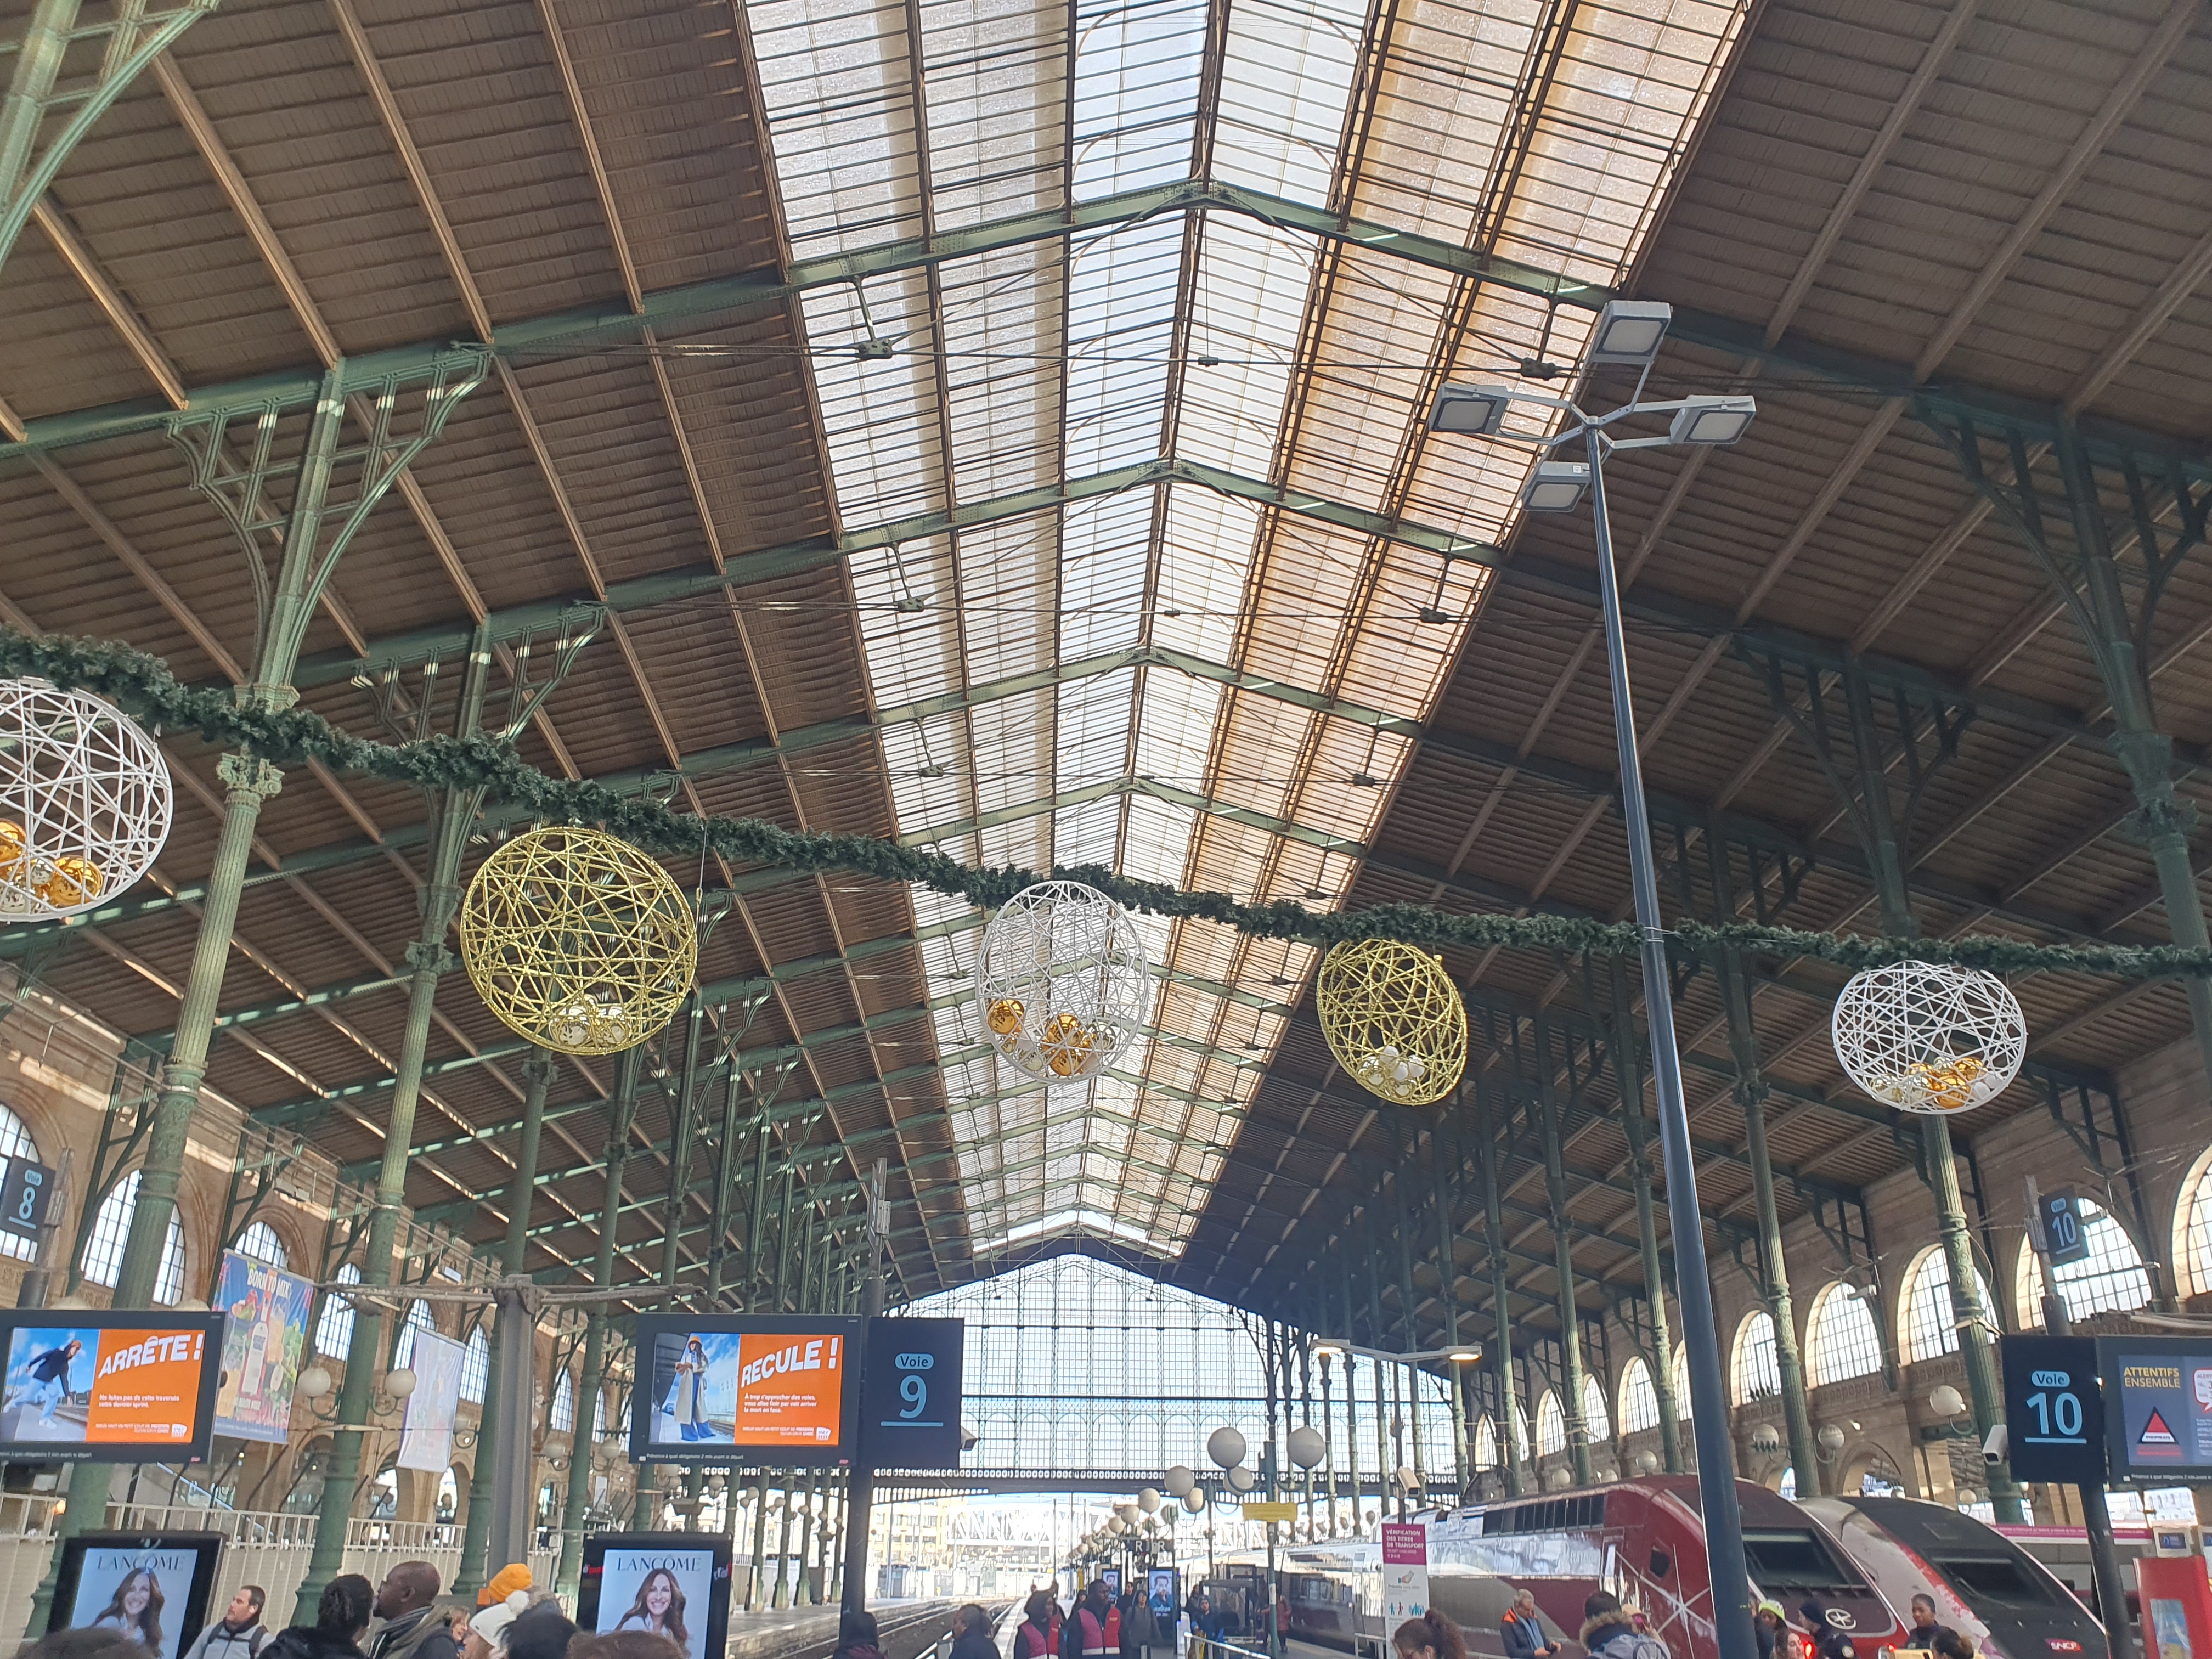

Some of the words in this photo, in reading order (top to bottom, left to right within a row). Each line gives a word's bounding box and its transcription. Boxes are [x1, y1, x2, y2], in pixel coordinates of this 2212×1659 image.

[19, 1186, 36, 1220] 8
[2052, 1212, 2076, 1247] 10
[247, 1268, 268, 1291] BORN
[266, 1276, 277, 1294] TO
[98, 1334, 191, 1379] ARRÊTE
[741, 1339, 823, 1389] RECULE
[900, 1356, 929, 1367] Voie
[2036, 1373, 2064, 1385] Voie
[2124, 1367, 2180, 1378] ATTENTIFS
[2124, 1377, 2181, 1389] ENSEMBLE
[899, 1375, 927, 1419] 9
[2026, 1392, 2083, 1436] 10
[1386, 1528, 1420, 1537] VÉRIFICATION
[1135, 1541, 1143, 1552] R
[617, 1554, 702, 1572] LANCÔME
